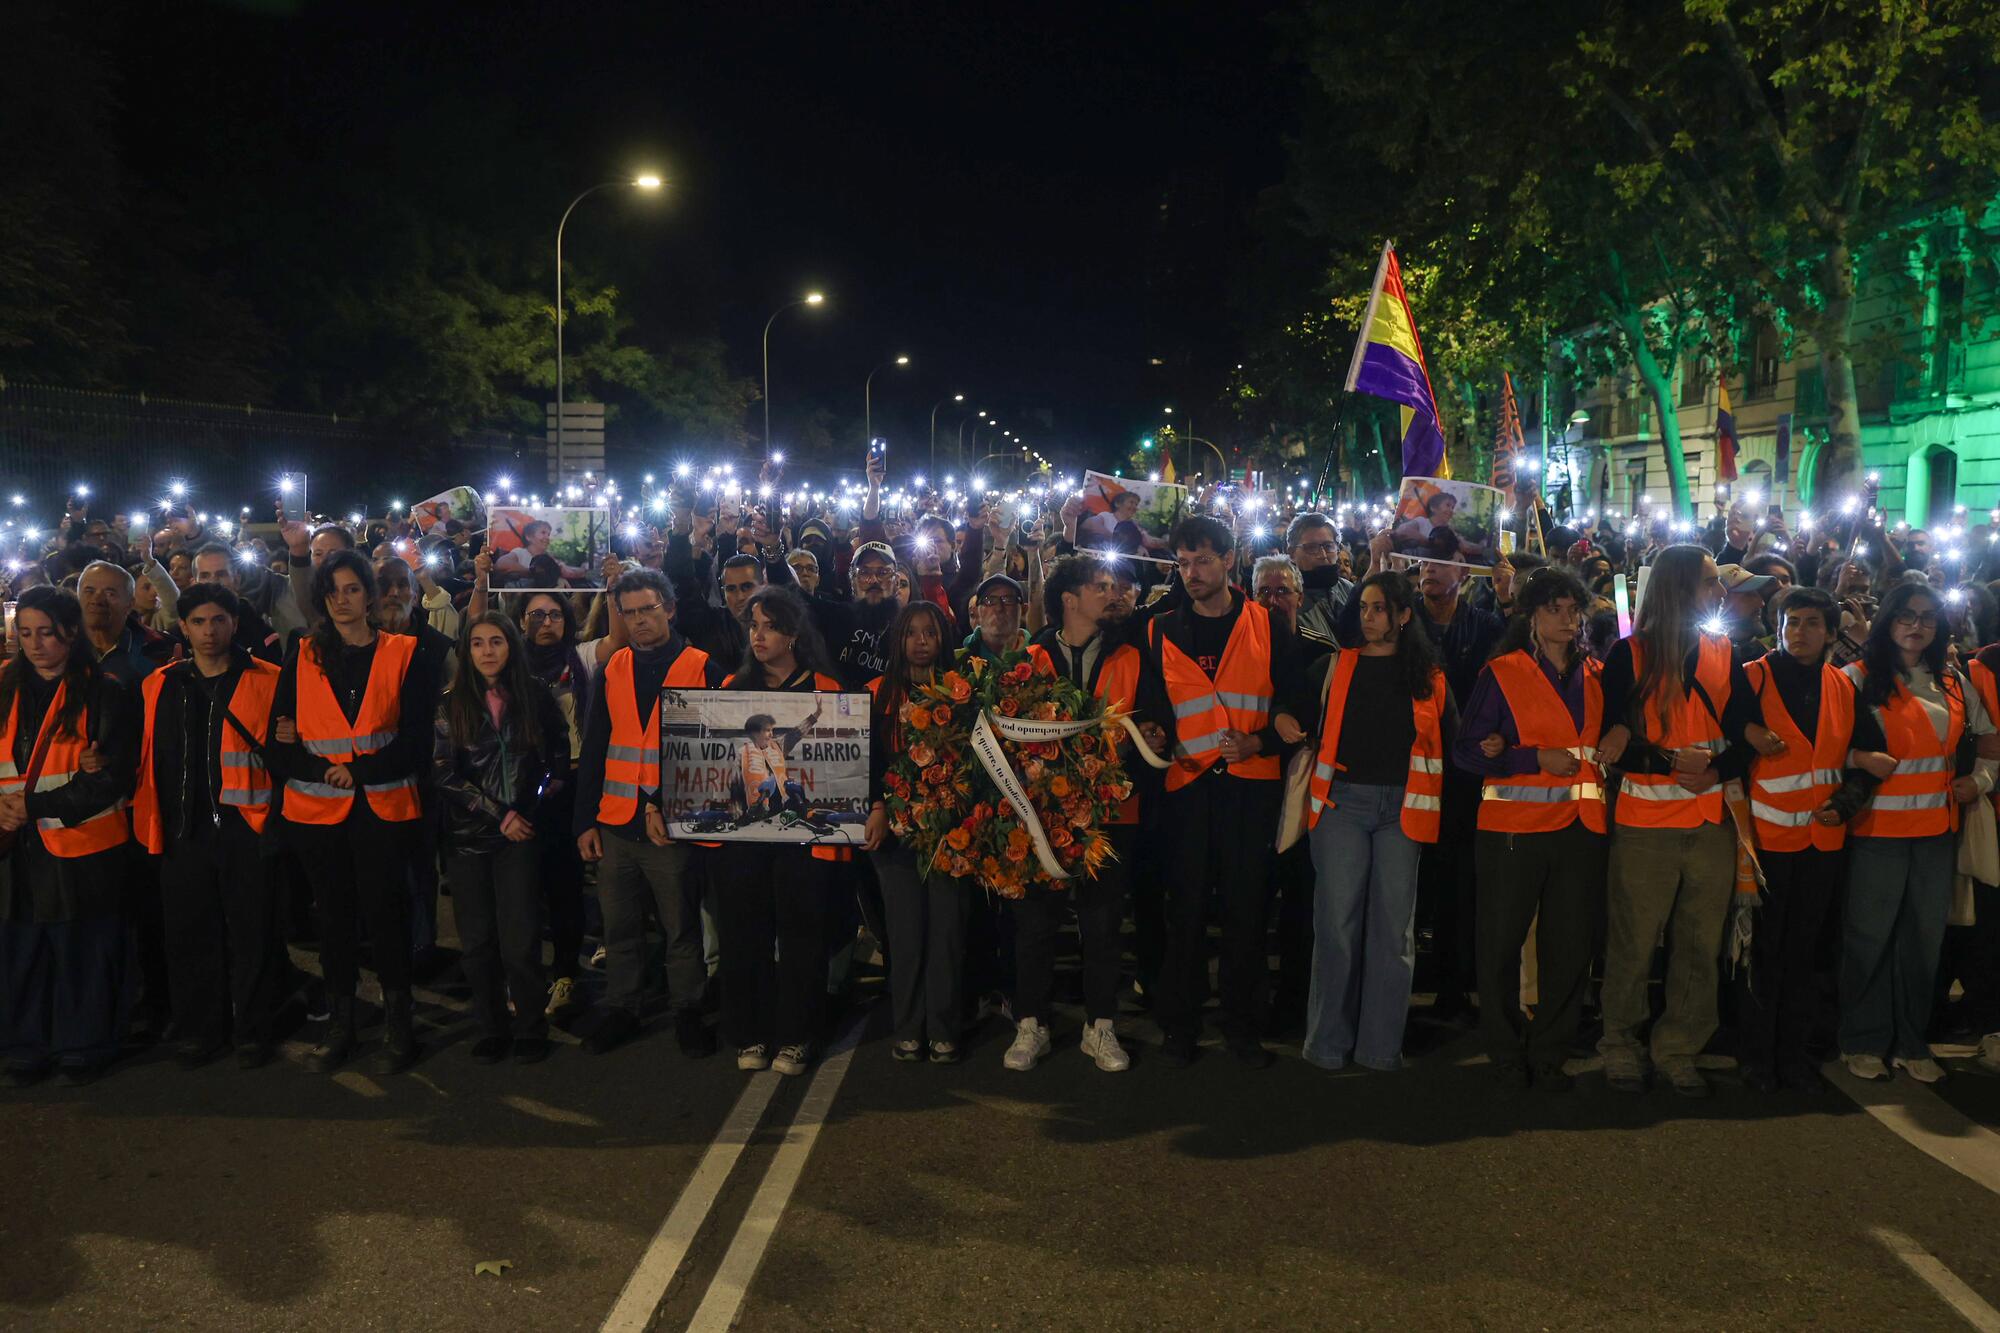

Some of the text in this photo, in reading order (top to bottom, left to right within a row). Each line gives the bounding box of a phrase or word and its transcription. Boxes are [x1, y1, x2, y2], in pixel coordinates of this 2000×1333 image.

[1001, 723, 1015, 732] por
[1017, 725, 1061, 736] luchando
[701, 742, 736, 761] VIDA
[802, 742, 861, 761] BARRIO
[974, 725, 1029, 816] Te quiere, tu Sindicato.
